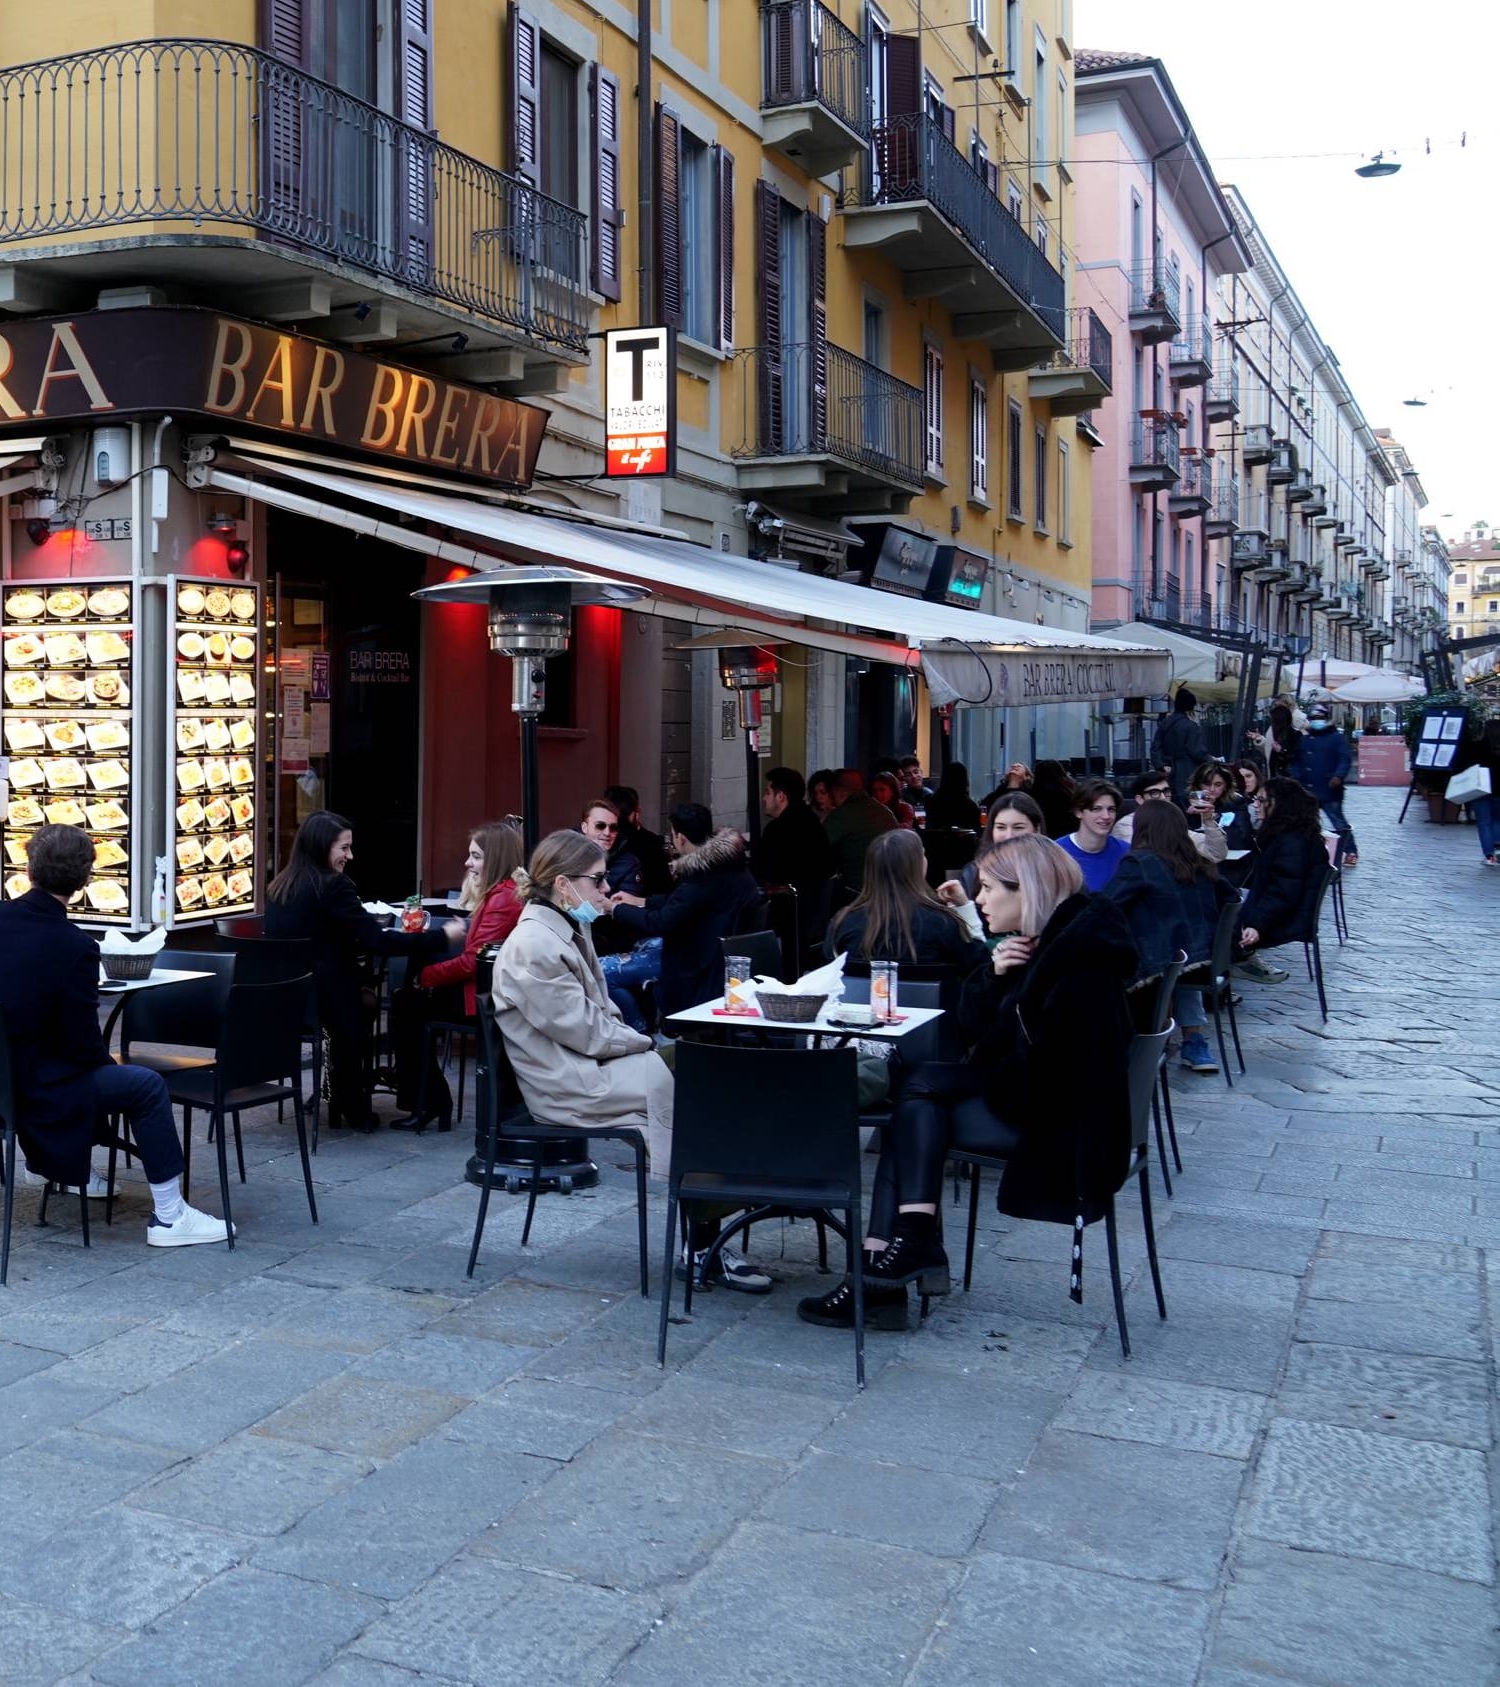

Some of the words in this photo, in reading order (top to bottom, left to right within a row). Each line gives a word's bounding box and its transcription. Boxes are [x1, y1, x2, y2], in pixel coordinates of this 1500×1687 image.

[616, 336, 659, 401] T
[204, 319, 337, 438] BAR
[361, 363, 530, 483] BRERA
[611, 404, 665, 418] TABACCHI
[349, 650, 372, 669] BAR
[375, 651, 410, 670] BRERA
[1023, 663, 1042, 697] BAR
[1044, 663, 1074, 696] BRERA
